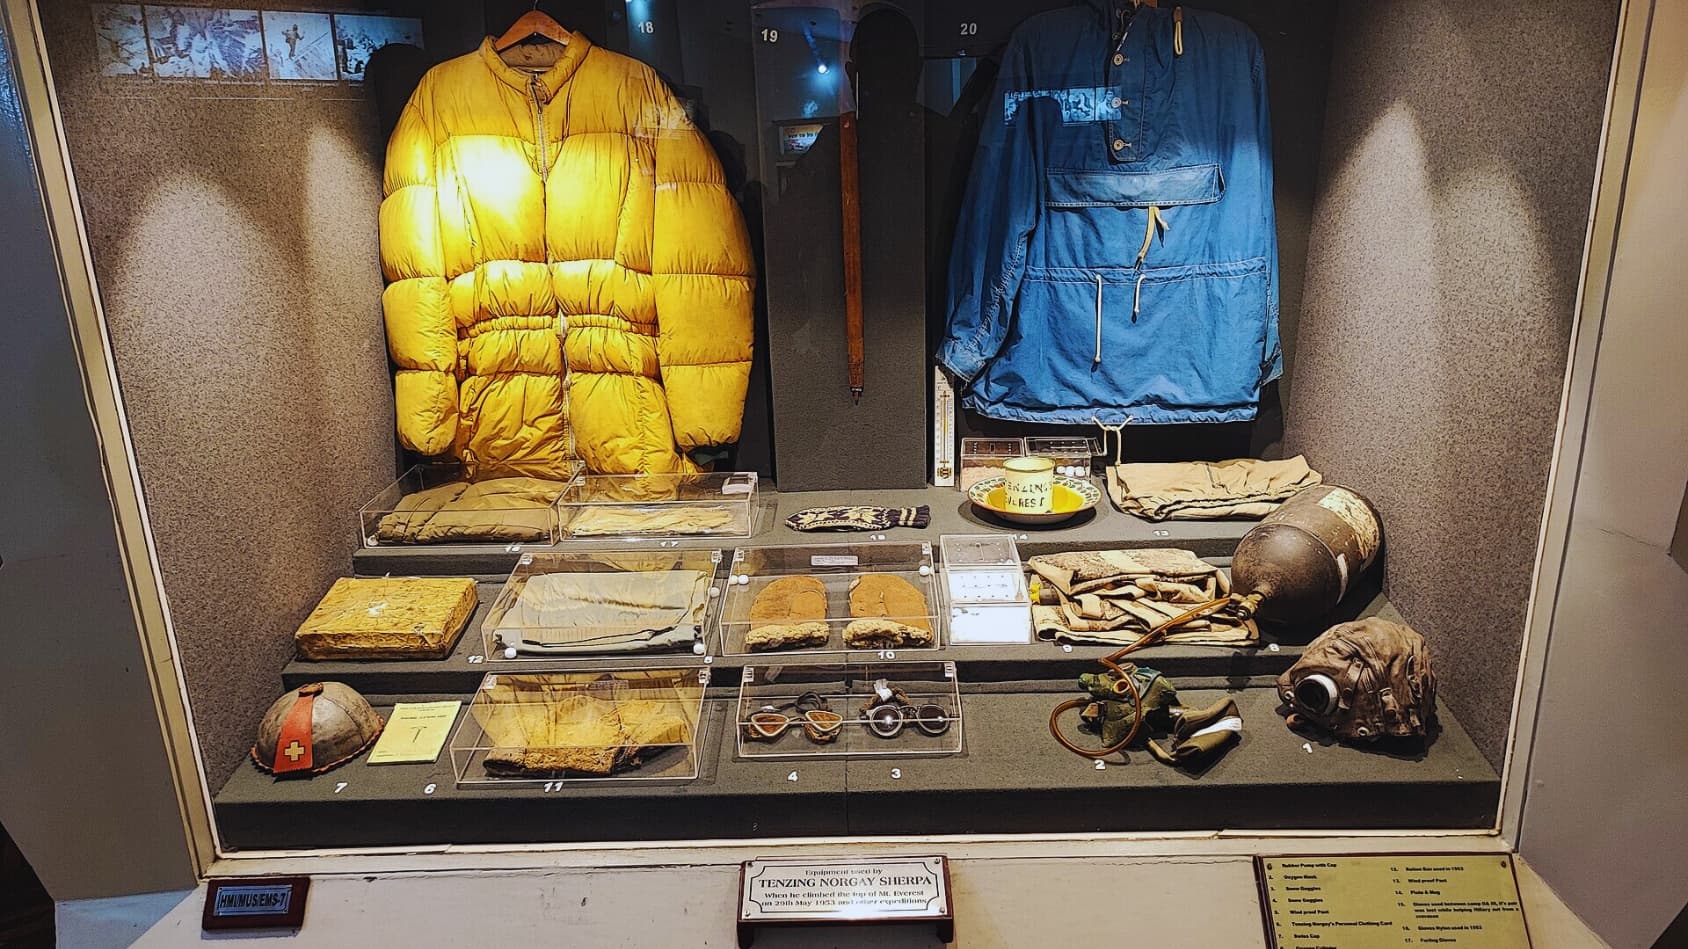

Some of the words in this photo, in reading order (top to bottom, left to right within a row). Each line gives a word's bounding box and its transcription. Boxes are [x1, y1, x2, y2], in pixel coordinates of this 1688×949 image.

[638, 22, 654, 34] 18
[961, 23, 978, 35] 20
[761, 29, 778, 43] 19
[468, 655, 484, 664] 12
[879, 651, 895, 660] 10
[1302, 743, 1312, 753] 1
[1094, 759, 1105, 770] 2
[787, 771, 798, 782] 4
[891, 768, 901, 779] 3
[335, 782, 348, 793] 7
[424, 784, 436, 794] 6
[545, 782, 563, 792] 11
[759, 879, 816, 888] TENZING
[820, 877, 875, 888] NORGAY
[880, 876, 932, 886] SHERPA
